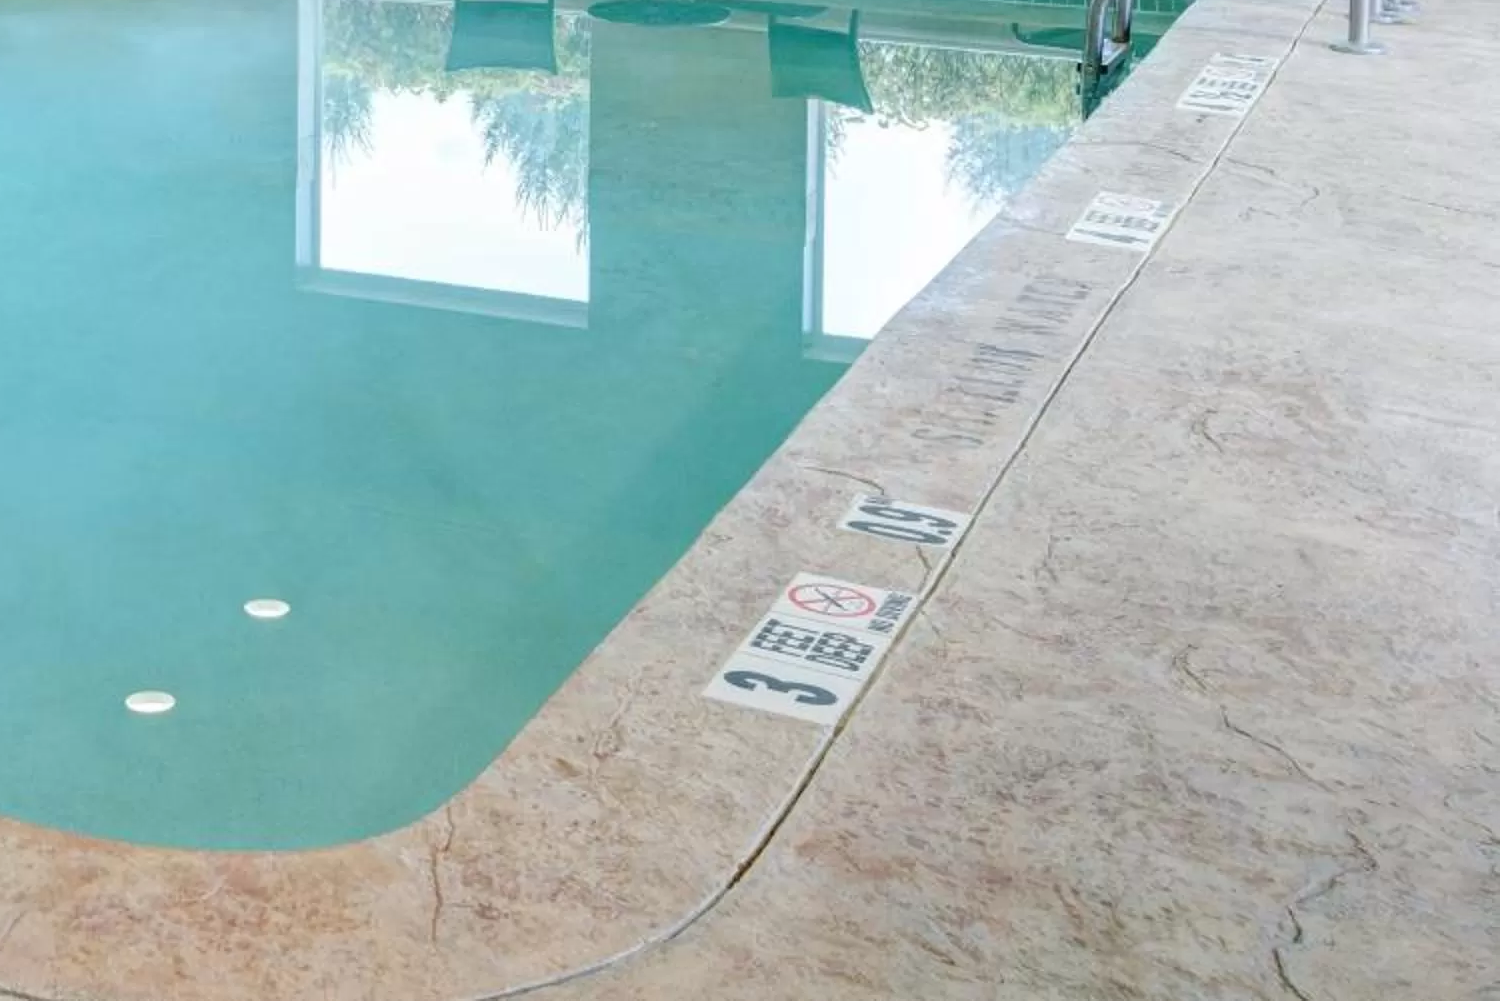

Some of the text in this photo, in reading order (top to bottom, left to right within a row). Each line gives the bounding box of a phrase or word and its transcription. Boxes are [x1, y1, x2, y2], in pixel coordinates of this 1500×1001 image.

[750, 618, 820, 657] FEET
[804, 631, 874, 671] DEEP
[723, 670, 838, 705] 3
